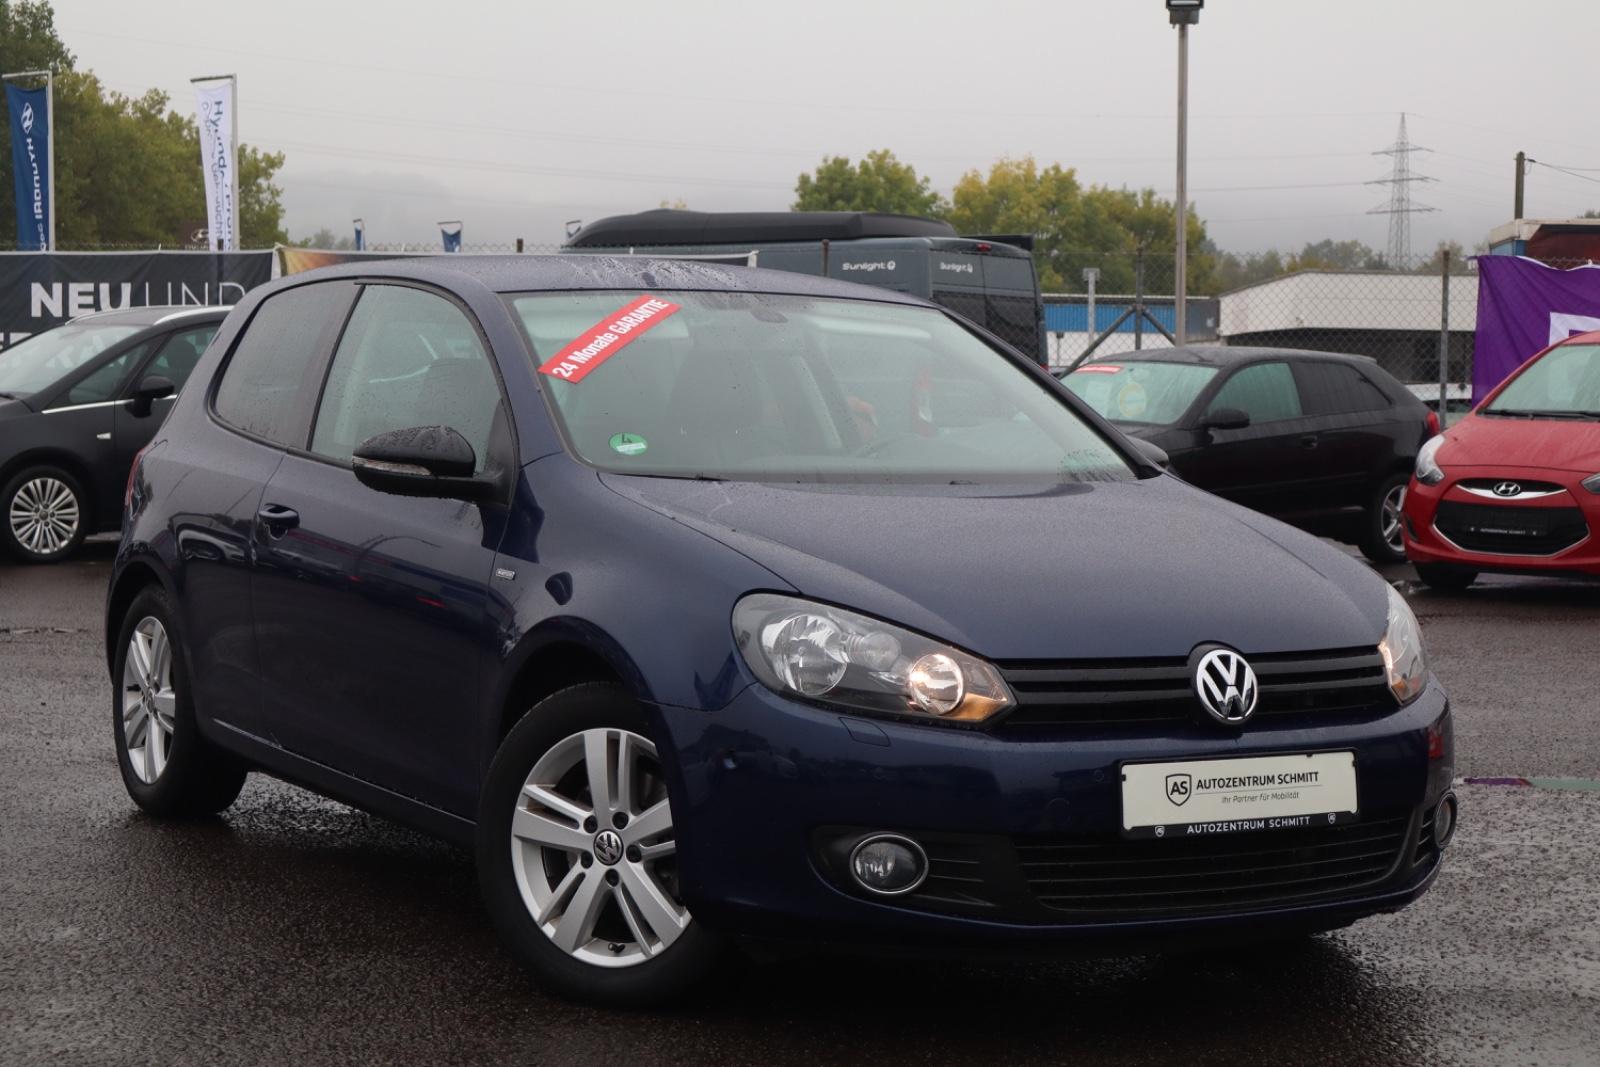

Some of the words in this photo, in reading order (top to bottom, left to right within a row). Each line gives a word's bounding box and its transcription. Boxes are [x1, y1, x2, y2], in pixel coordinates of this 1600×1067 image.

[842, 261, 886, 272] Sunlight
[31, 282, 131, 318] NEU
[552, 361, 579, 378] 24
[568, 332, 619, 364] Monate
[609, 299, 669, 334] GARANTIE
[1170, 780, 1188, 796] AS
[1197, 776, 1275, 790] AUTOZENTRUM
[1278, 772, 1319, 784] SCHMITT
[1233, 794, 1259, 803] Partner
[1187, 821, 1265, 834] AUTOZENTRUM
[1269, 816, 1310, 828] SCHMITT
